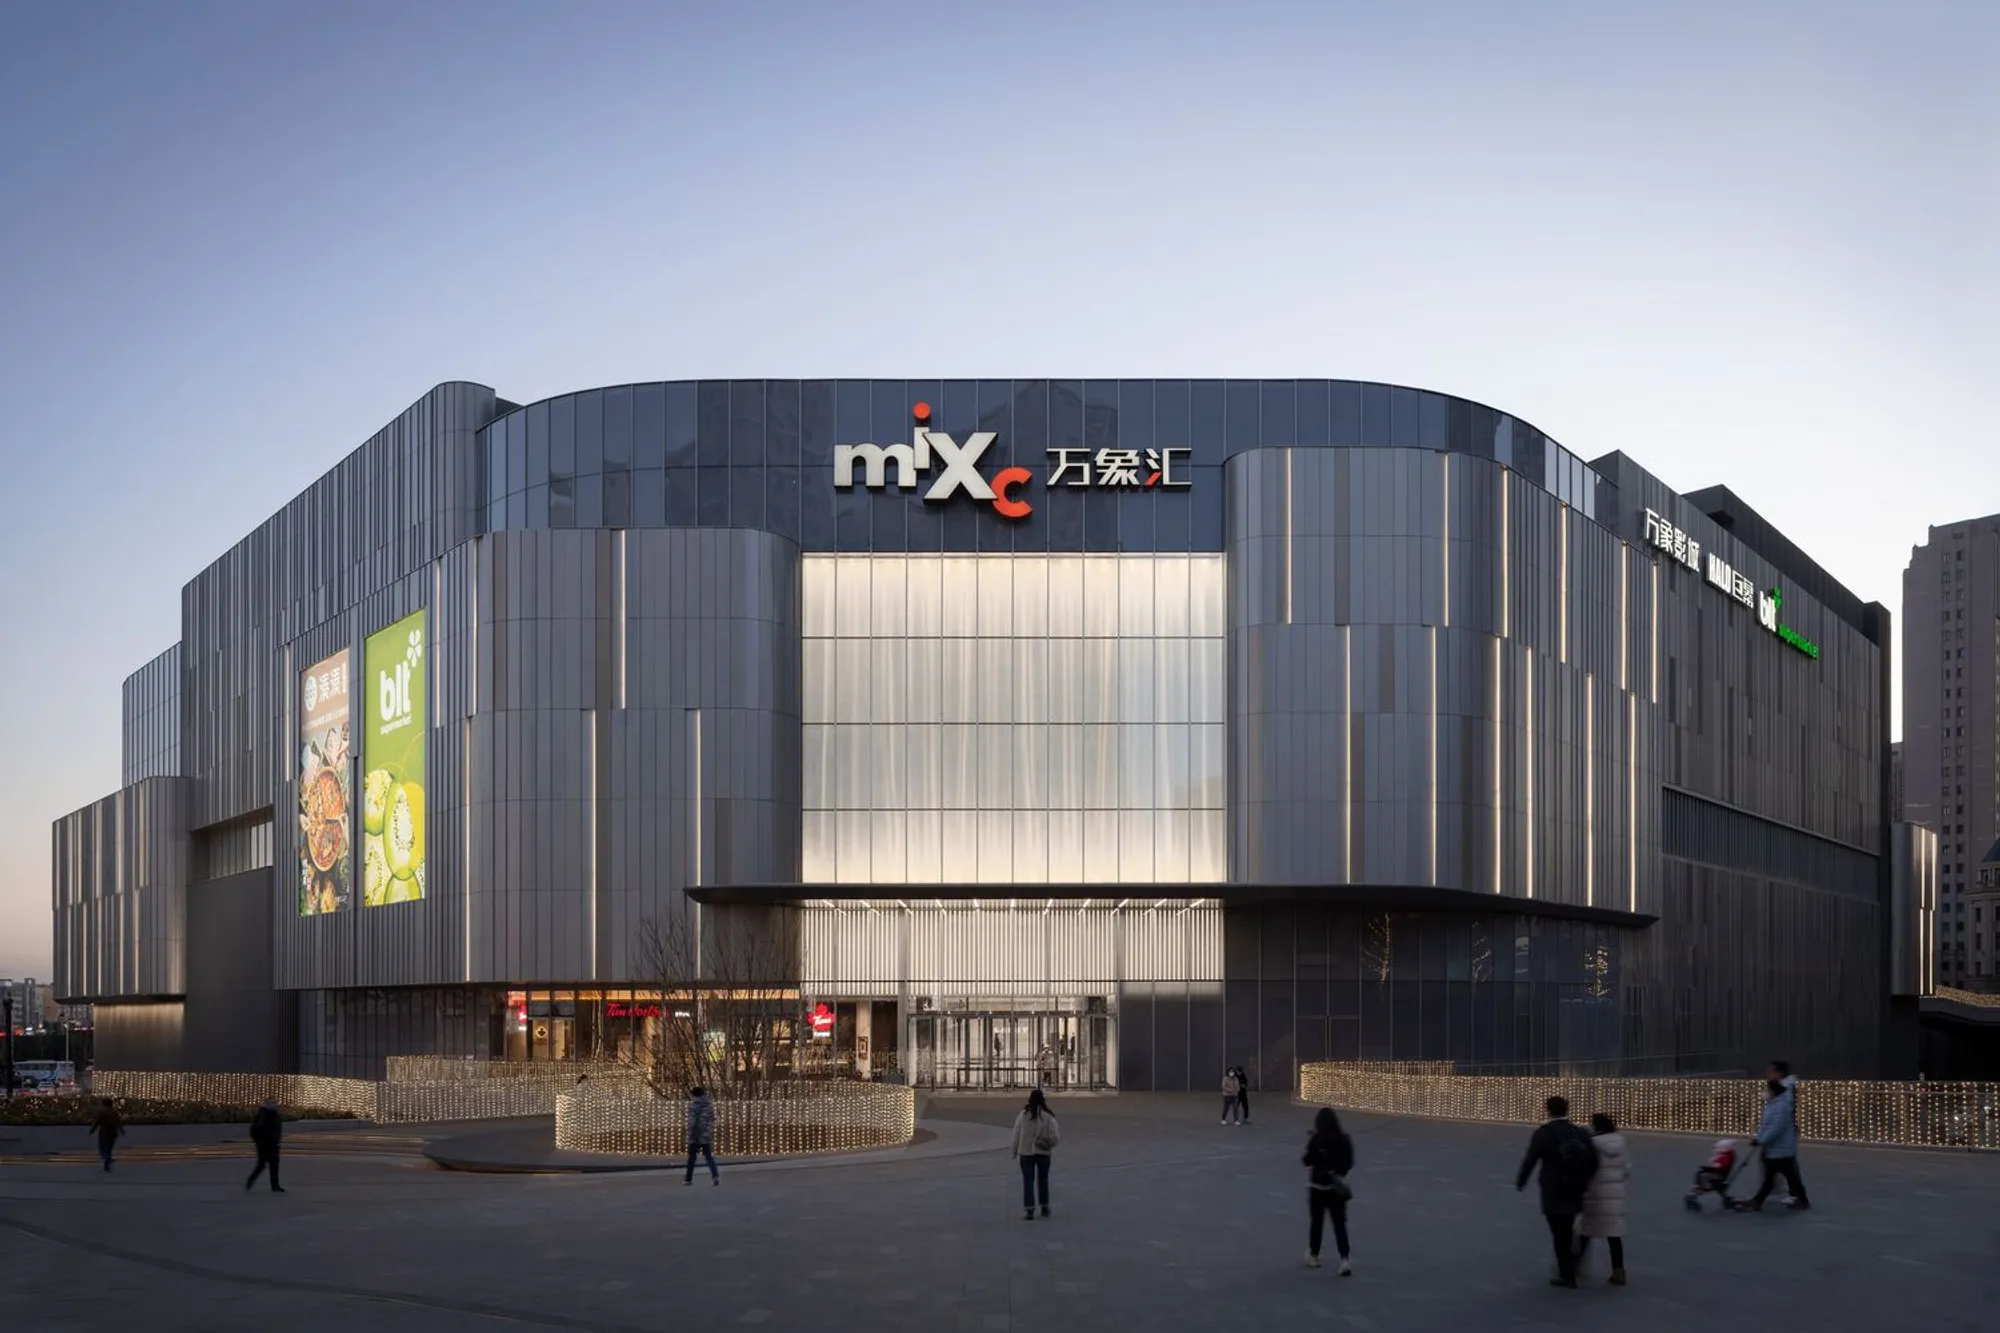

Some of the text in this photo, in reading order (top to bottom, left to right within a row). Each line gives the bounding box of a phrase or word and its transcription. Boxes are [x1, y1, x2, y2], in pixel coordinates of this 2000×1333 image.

[1046, 447, 1192, 486] 万象汇
[1645, 507, 1700, 572] 万象影城
[380, 660, 411, 721] blt
